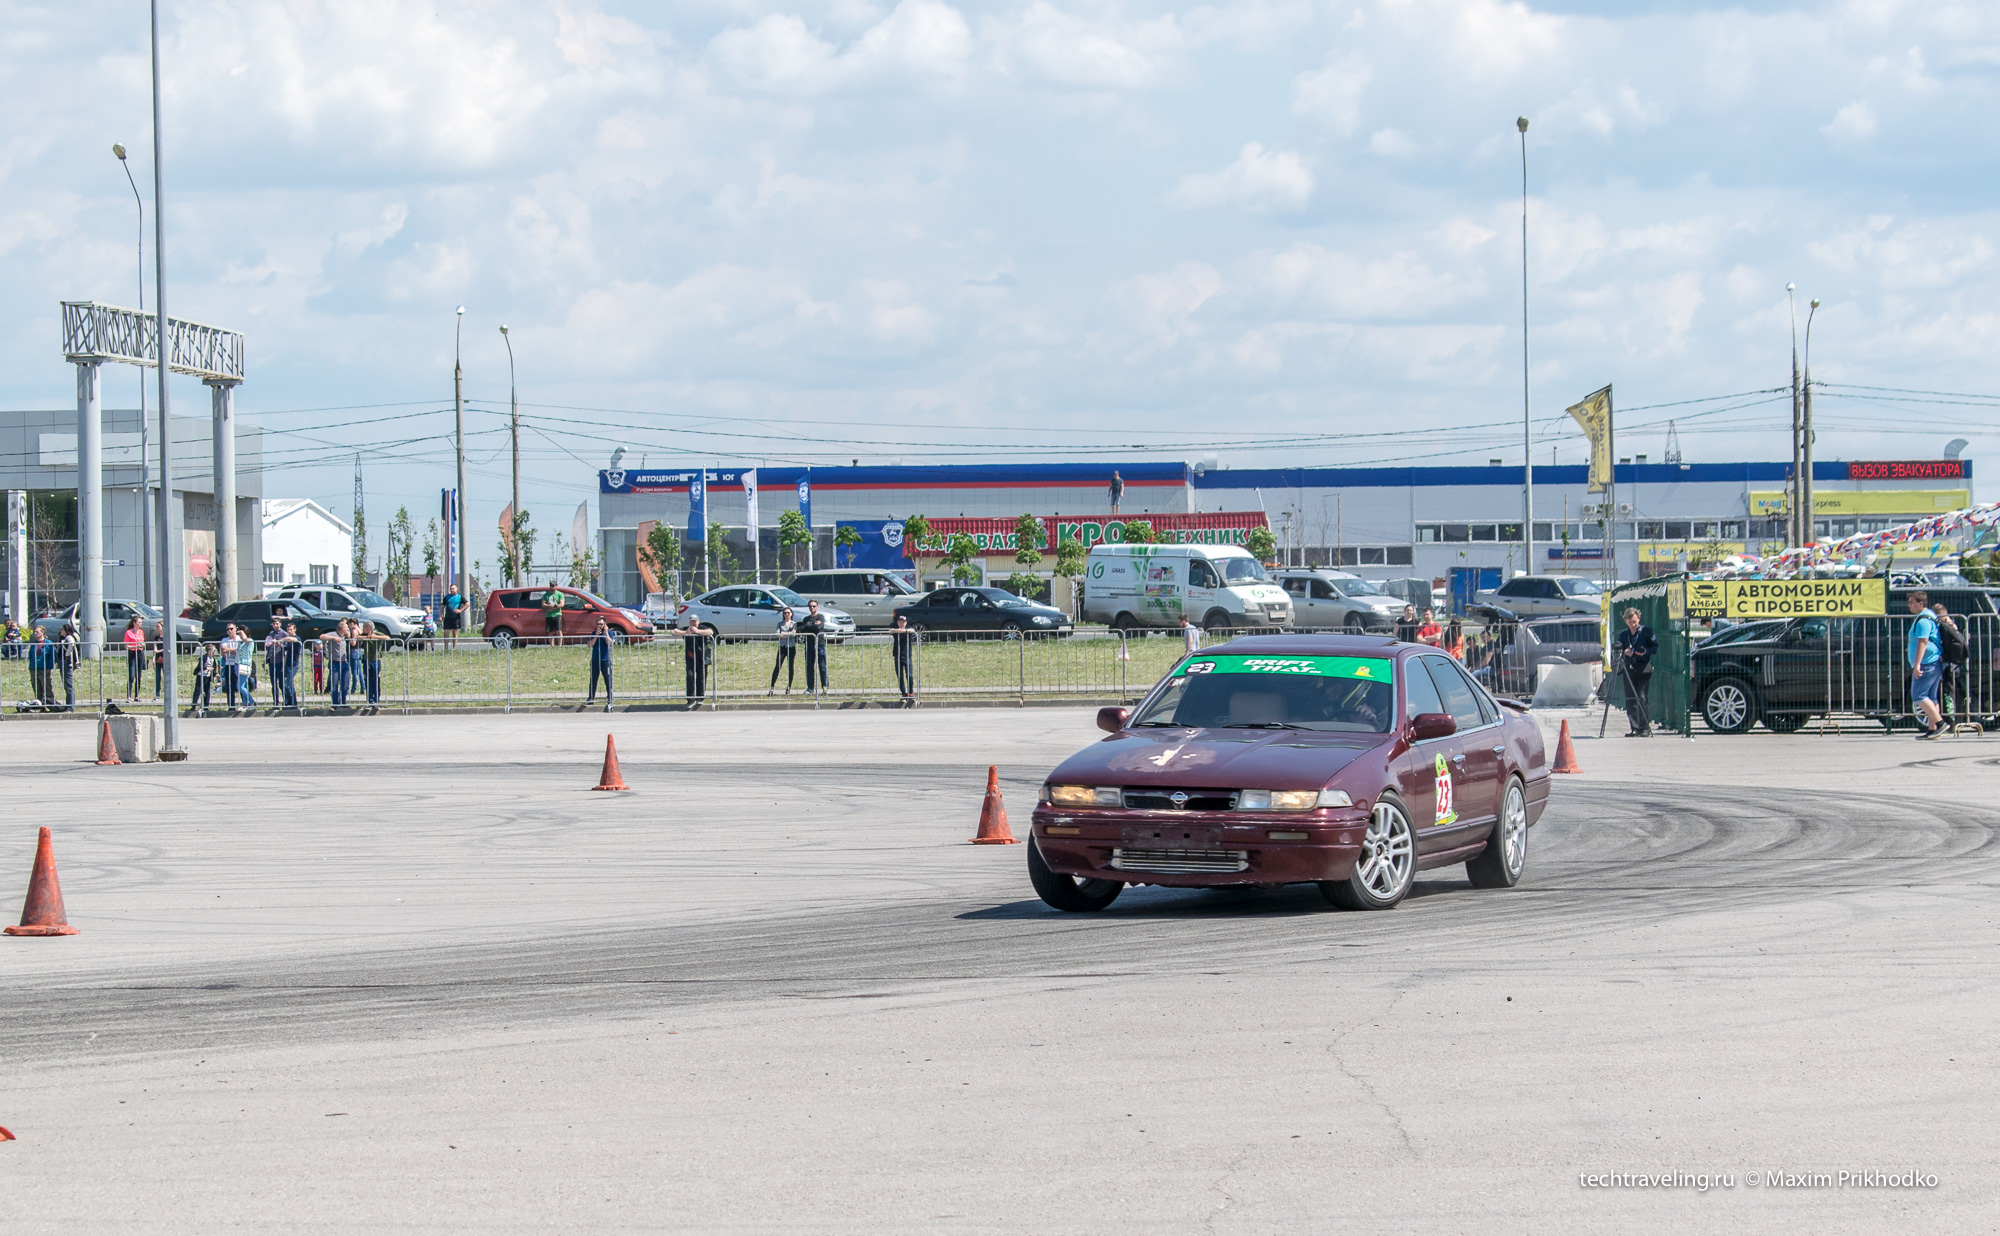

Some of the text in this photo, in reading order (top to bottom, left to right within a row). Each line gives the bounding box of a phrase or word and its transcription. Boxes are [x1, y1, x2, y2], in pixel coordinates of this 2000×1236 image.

[1852, 463, 1961, 478] ВЫЗОВ ЭВАКУАТОРА
[1758, 500, 1782, 508] Mobil
[1737, 583, 1862, 597] АВТОМОБИЛИ
[1690, 600, 1723, 608] АМБАР
[1737, 599, 1853, 613] С ПРОБЕГОМ
[1187, 662, 1216, 674] 23
[1242, 659, 1316, 667] DRIFT
[1437, 780, 1449, 814] 23
